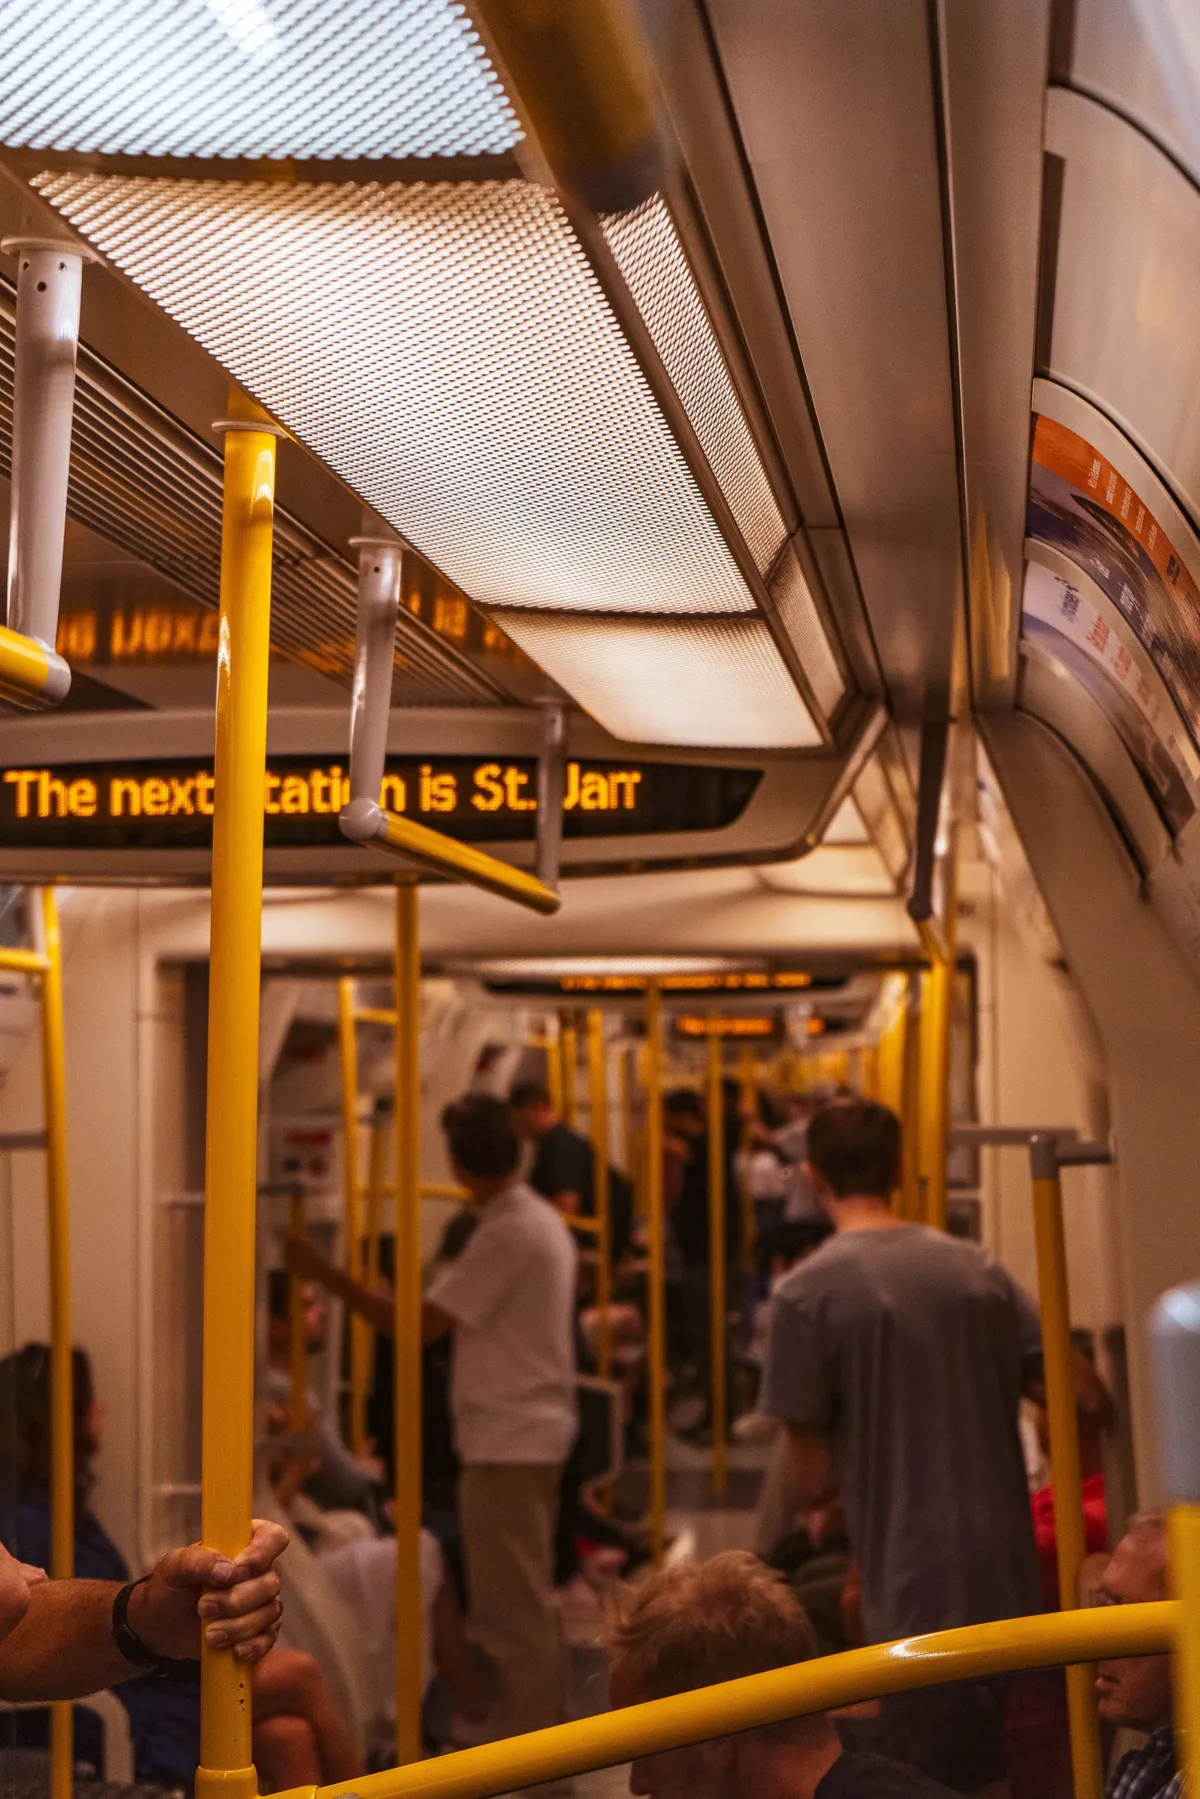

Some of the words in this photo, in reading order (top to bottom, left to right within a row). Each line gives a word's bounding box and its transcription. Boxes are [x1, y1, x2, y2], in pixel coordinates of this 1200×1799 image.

[4, 769, 97, 817] The
[109, 771, 215, 816] next
[264, 765, 405, 813] tatin
[419, 765, 457, 811] is
[471, 764, 537, 811] St.
